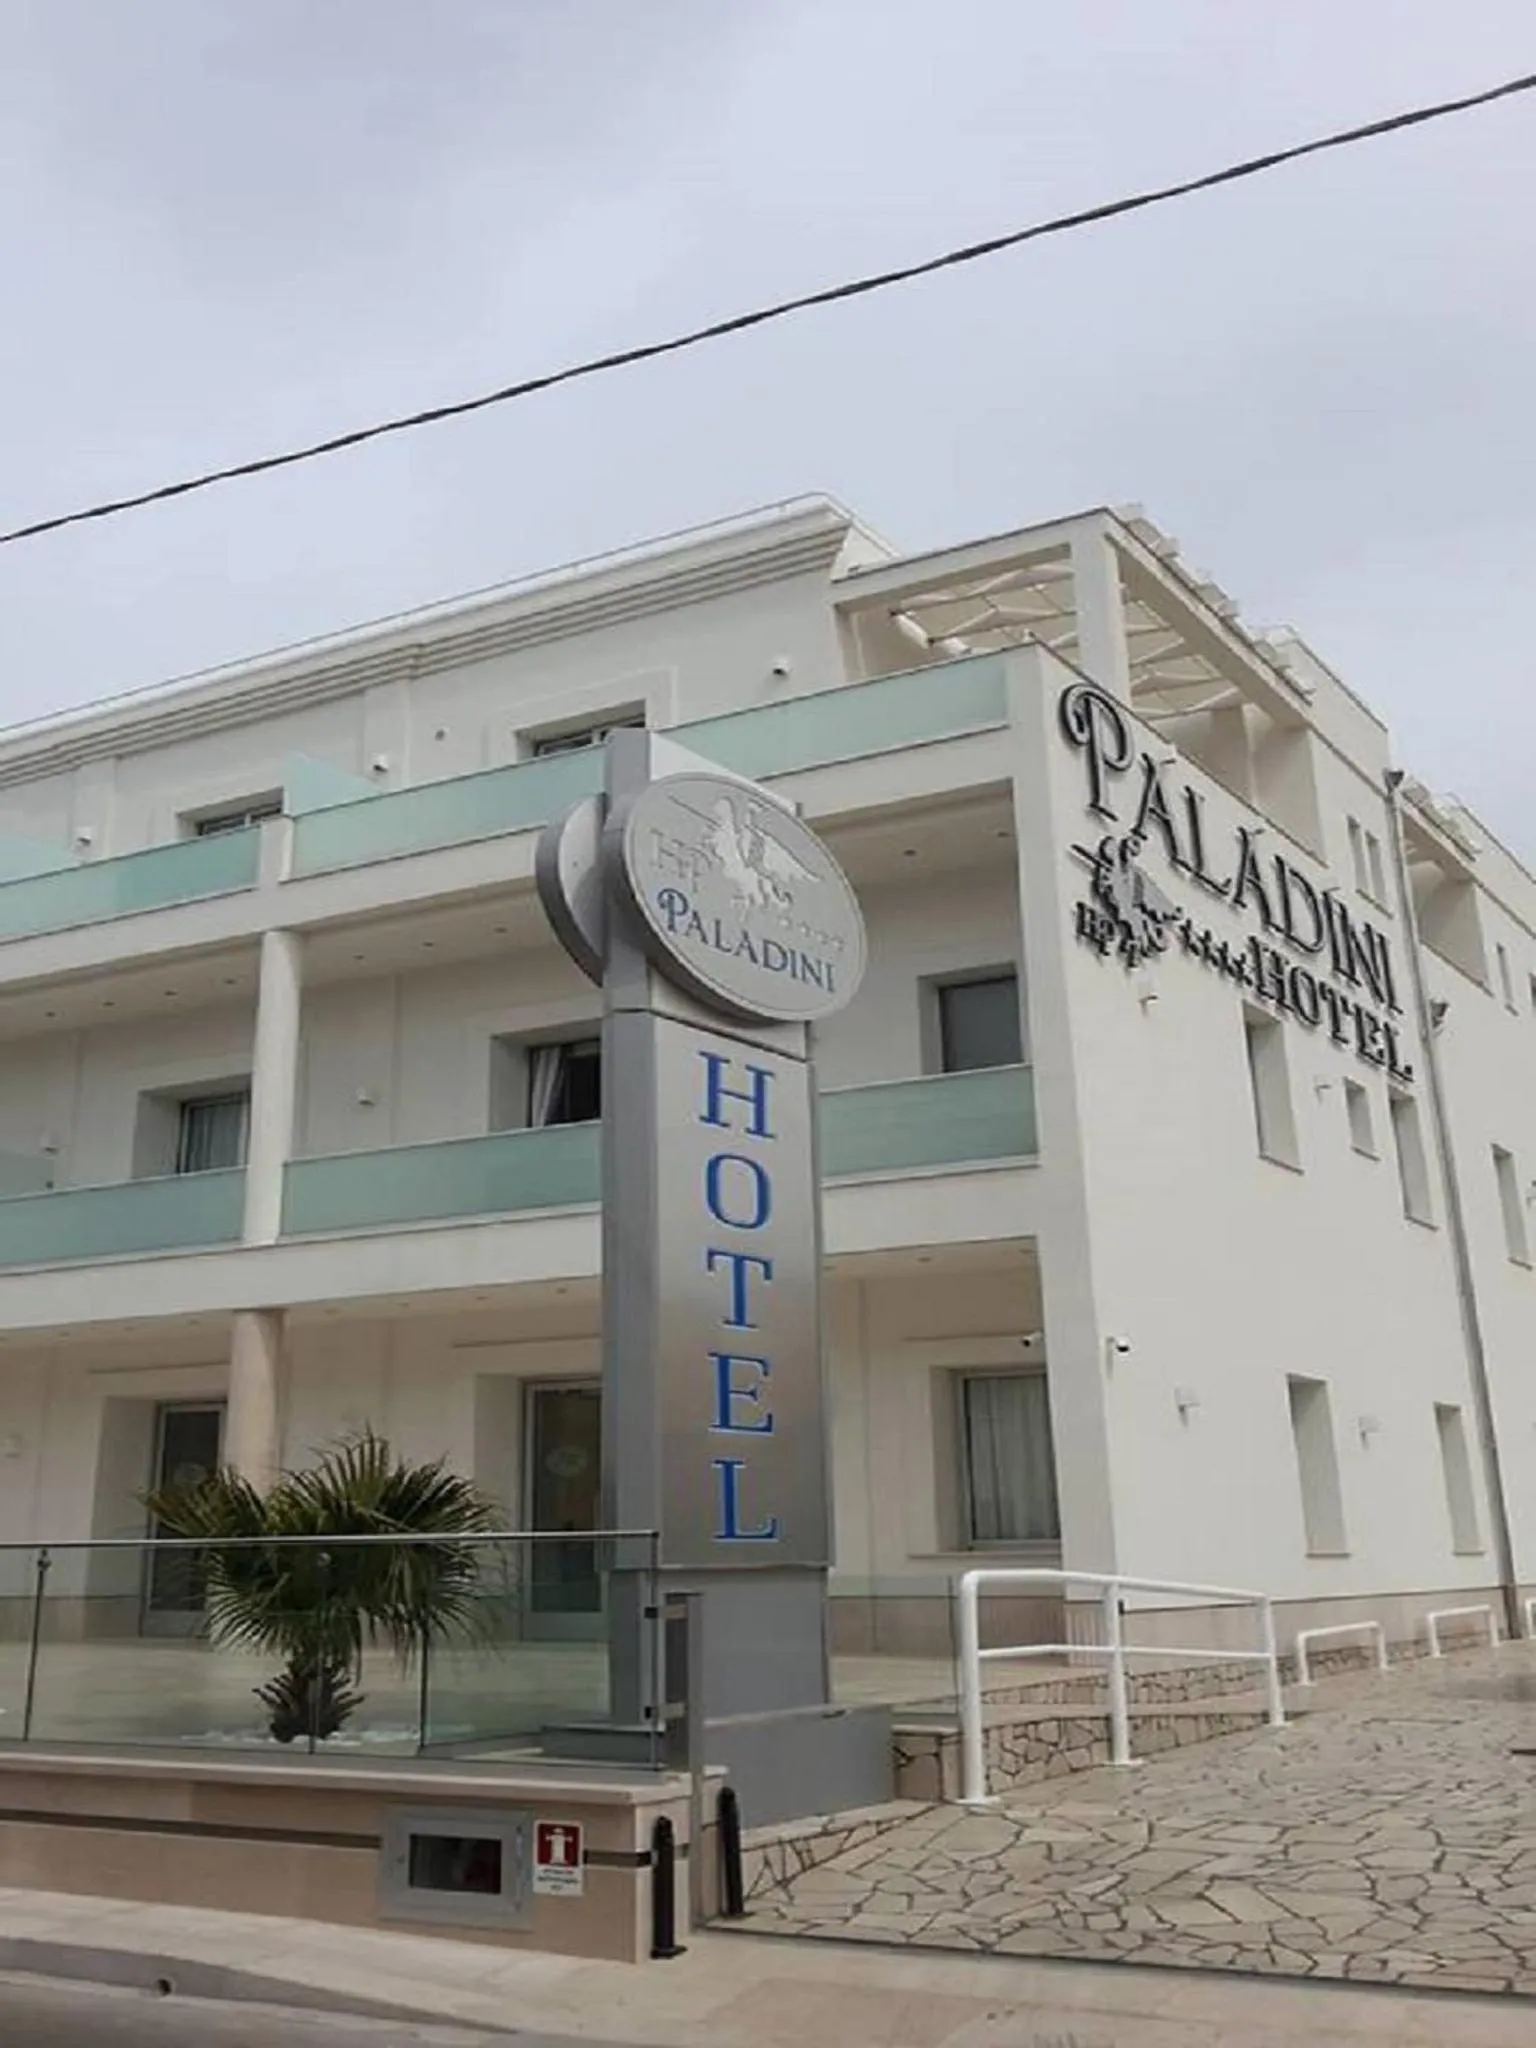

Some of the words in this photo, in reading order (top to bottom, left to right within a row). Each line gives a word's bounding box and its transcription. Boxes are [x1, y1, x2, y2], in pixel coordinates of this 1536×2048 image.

[657, 888, 835, 993] PALADINI
[1059, 683, 1404, 1015] PALADINI
[1247, 935, 1414, 1082] HOTEL
[698, 1050, 777, 1542] HOTEL
